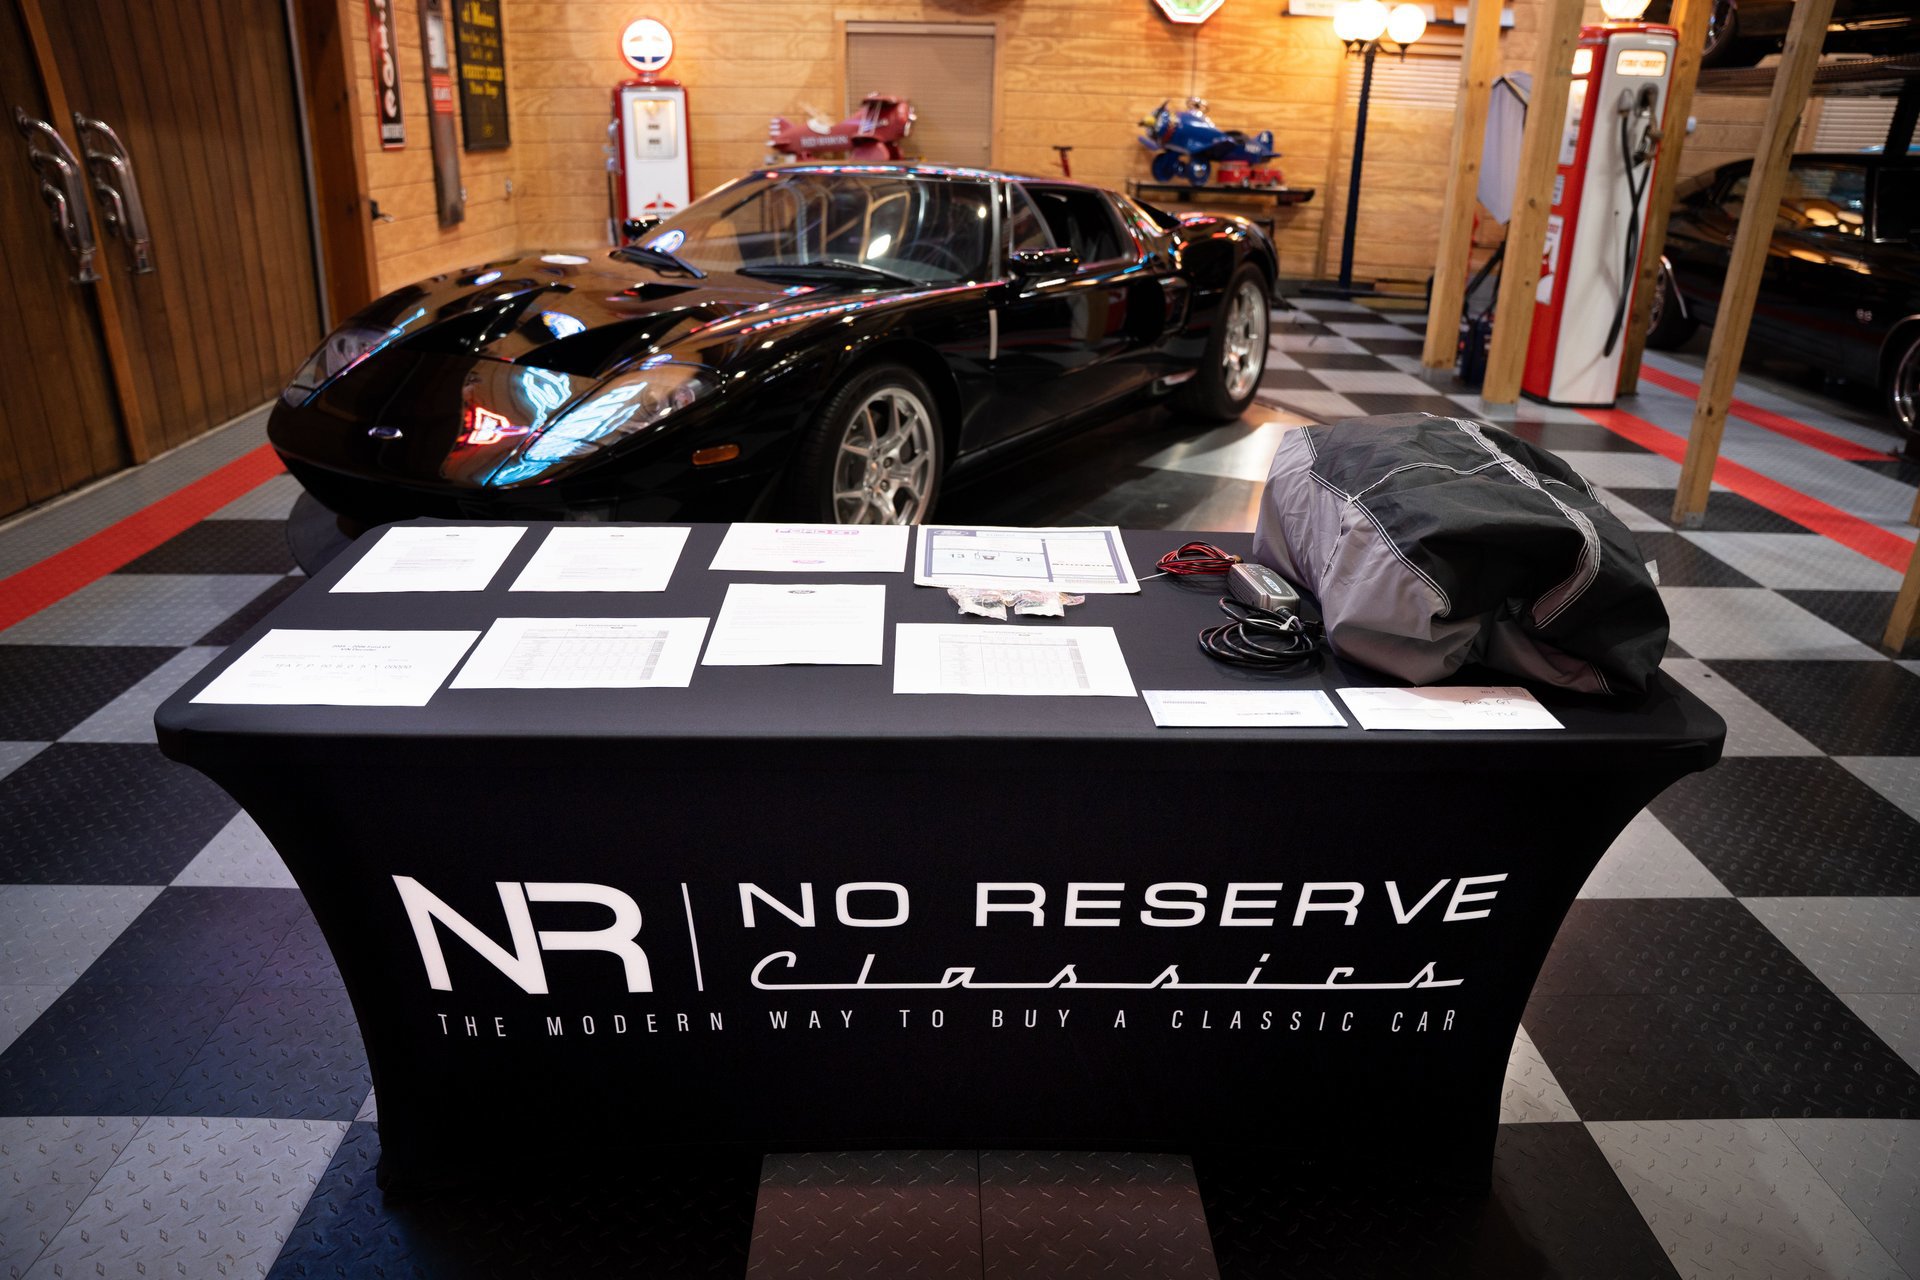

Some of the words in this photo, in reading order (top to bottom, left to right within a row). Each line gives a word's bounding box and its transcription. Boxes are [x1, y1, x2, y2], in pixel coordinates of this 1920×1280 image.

[738, 881, 910, 928] NO
[975, 872, 1509, 928] RESERVE
[391, 874, 654, 995] NR
[750, 950, 1465, 991] Classics
[437, 1013, 507, 1037] THE
[546, 1012, 724, 1036] MODERN
[769, 1009, 853, 1030] WAY
[899, 1009, 944, 1029] TO
[992, 1009, 1070, 1029] BUY
[1113, 1009, 1126, 1029] A
[1171, 1009, 1354, 1032] CLASSIC
[1391, 1009, 1456, 1033] CAR
